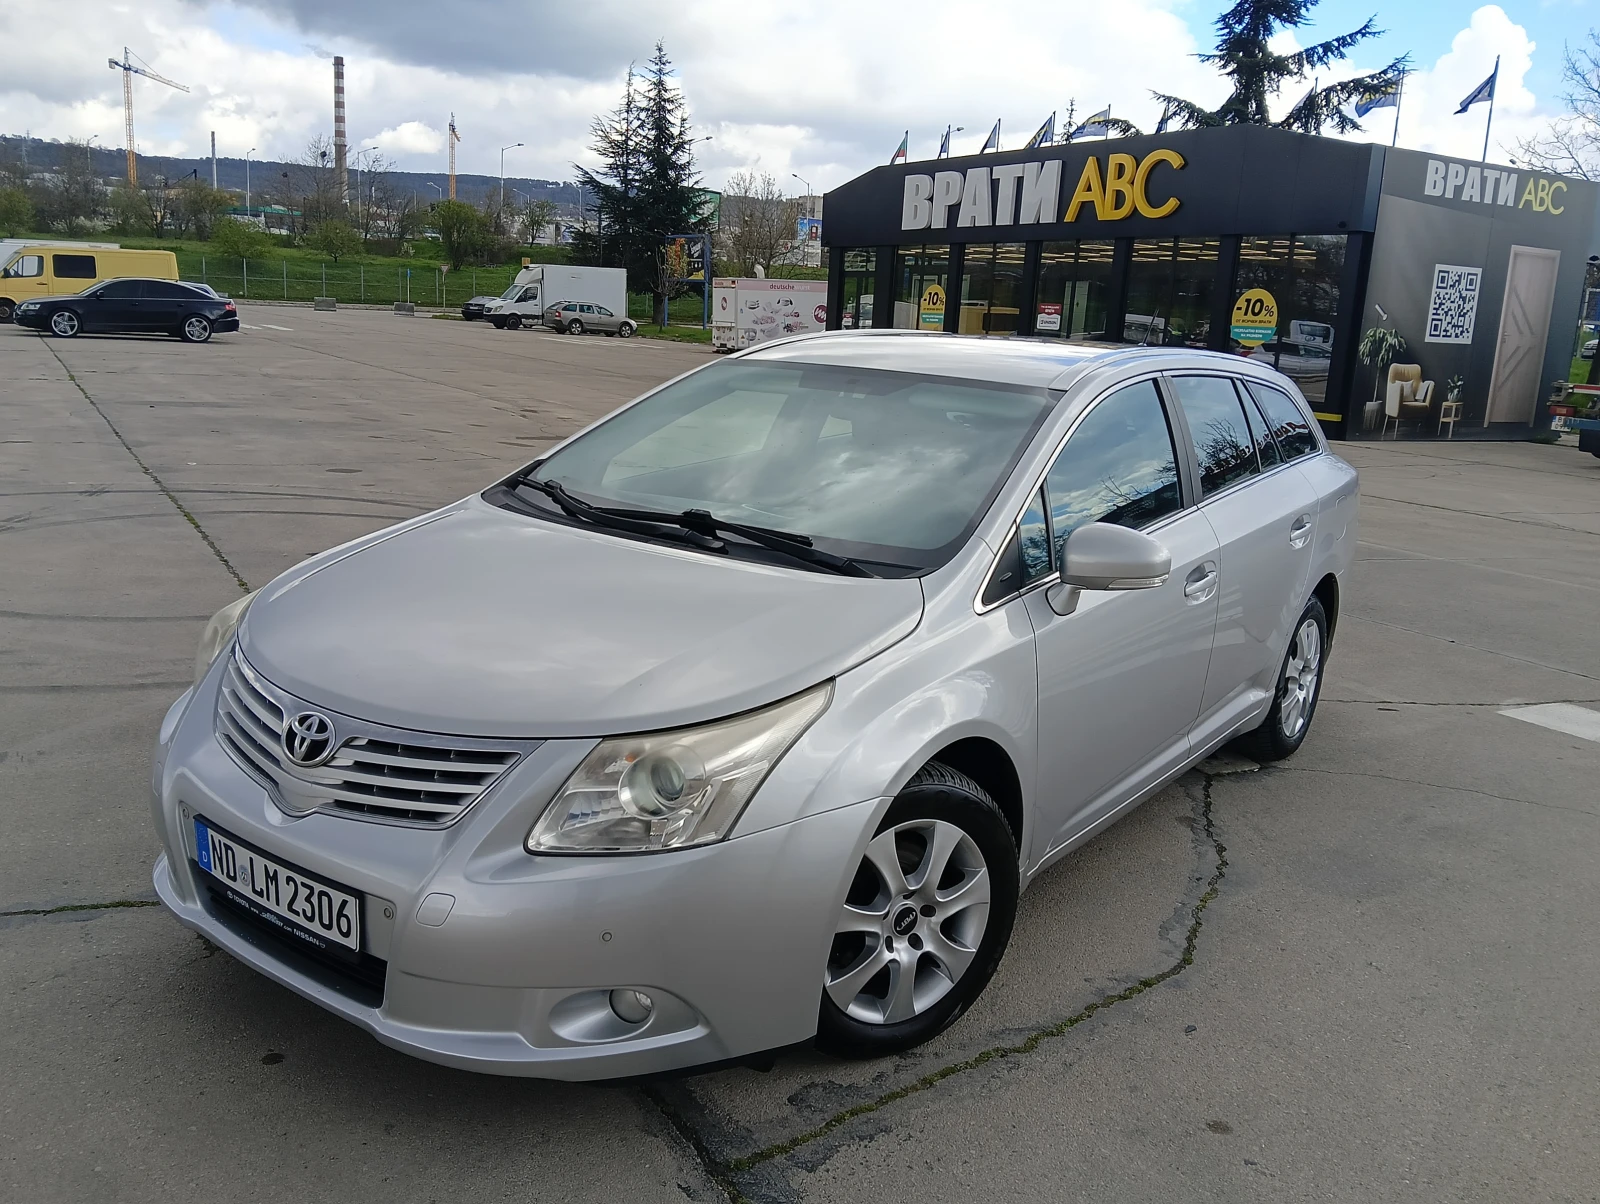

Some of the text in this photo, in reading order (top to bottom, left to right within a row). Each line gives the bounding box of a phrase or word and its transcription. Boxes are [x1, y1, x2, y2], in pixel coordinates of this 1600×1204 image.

[901, 148, 1185, 230] ВРАТИ ABC
[1424, 159, 1568, 215] ВРАТИ ABC
[923, 291, 945, 306] -10%
[1236, 298, 1274, 317] -10%
[202, 851, 208, 862] D
[210, 833, 352, 939] ND LM 2306
[233, 895, 250, 908] TOYOTA
[293, 928, 320, 946] NISSAN
